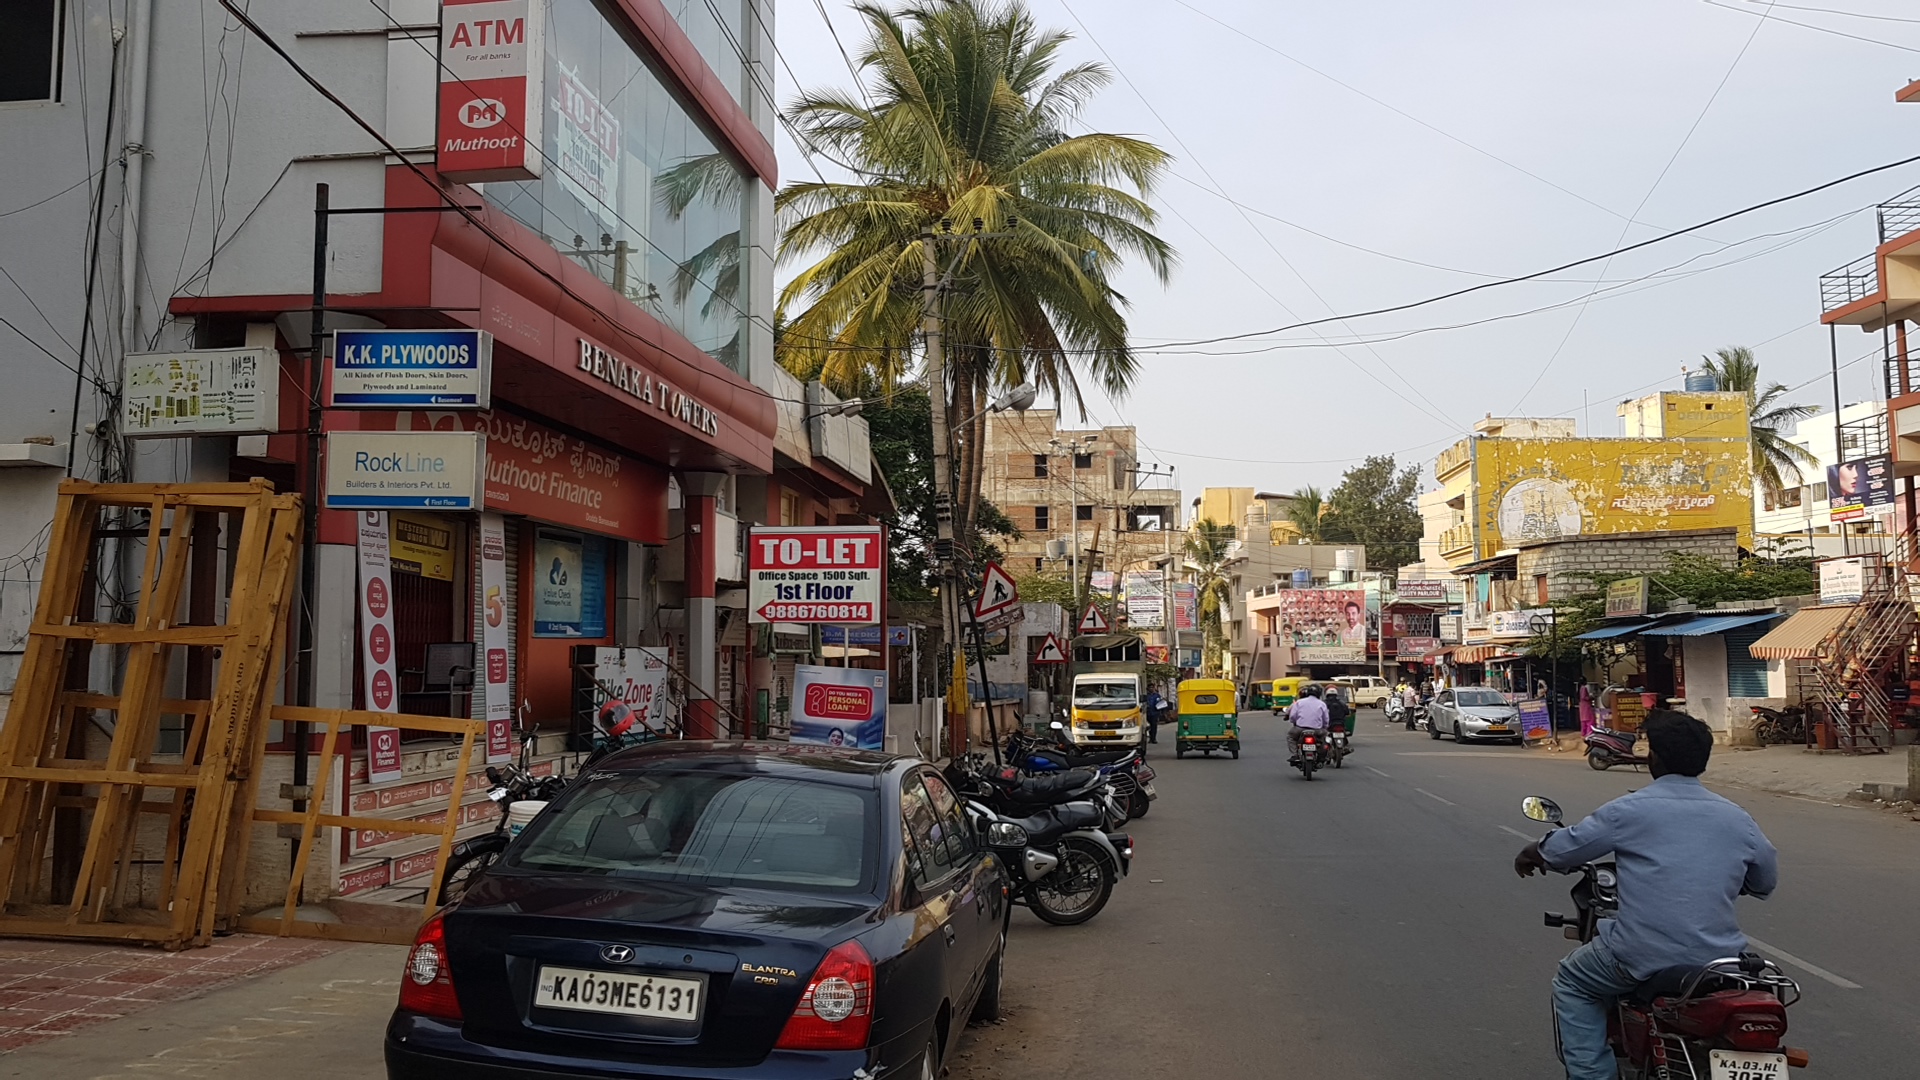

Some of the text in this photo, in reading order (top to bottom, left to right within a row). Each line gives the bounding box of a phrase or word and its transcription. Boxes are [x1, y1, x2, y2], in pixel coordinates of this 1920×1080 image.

[449, 18, 524, 49] ATM
[465, 52, 511, 62] For all banks
[443, 135, 518, 152] Muthoot
[344, 344, 469, 365] K.K. PLYWOODS
[405, 372, 428, 380] Doors,
[446, 372, 468, 380] Doors,
[577, 337, 653, 405] BENAKA
[355, 451, 444, 473] Rock Line
[346, 480, 377, 488] Builders
[387, 481, 418, 489] Interiors
[420, 481, 434, 489] Pvt.
[437, 481, 452, 489] Ltd.
[548, 472, 603, 509] Finance
[406, 532, 429, 544] UNION
[758, 538, 871, 565] TO-LET
[758, 571, 870, 581] Office Space 1500 Sqft.
[558, 588, 572, 599] Check
[774, 582, 854, 600] 1st Floor
[765, 605, 868, 618] 9886760814
[828, 696, 867, 705] PERSONAL
[491, 736, 508, 744] Muthoot
[375, 750, 396, 760] Muthoot
[376, 757, 396, 766] Finance
[741, 963, 797, 978] ELANTRA
[540, 974, 695, 1015] IND KA03ME6131
[1719, 1059, 1778, 1072] KA.03.HL
